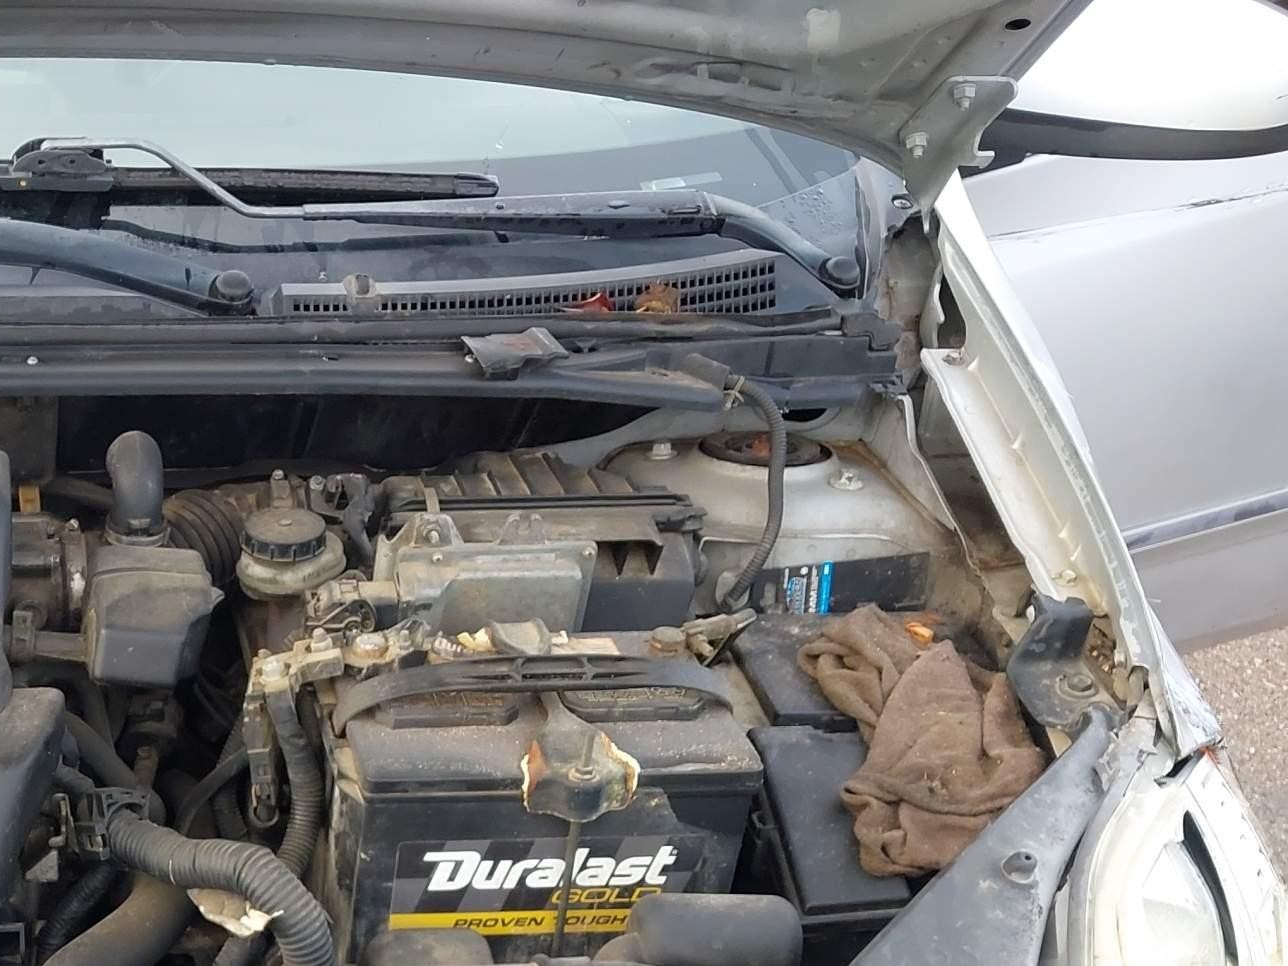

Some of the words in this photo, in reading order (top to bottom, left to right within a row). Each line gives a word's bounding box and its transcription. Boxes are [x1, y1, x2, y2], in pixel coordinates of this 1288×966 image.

[423, 845, 676, 892] Duralast
[453, 915, 545, 929] PROVEN
[553, 914, 627, 926] OUGH
